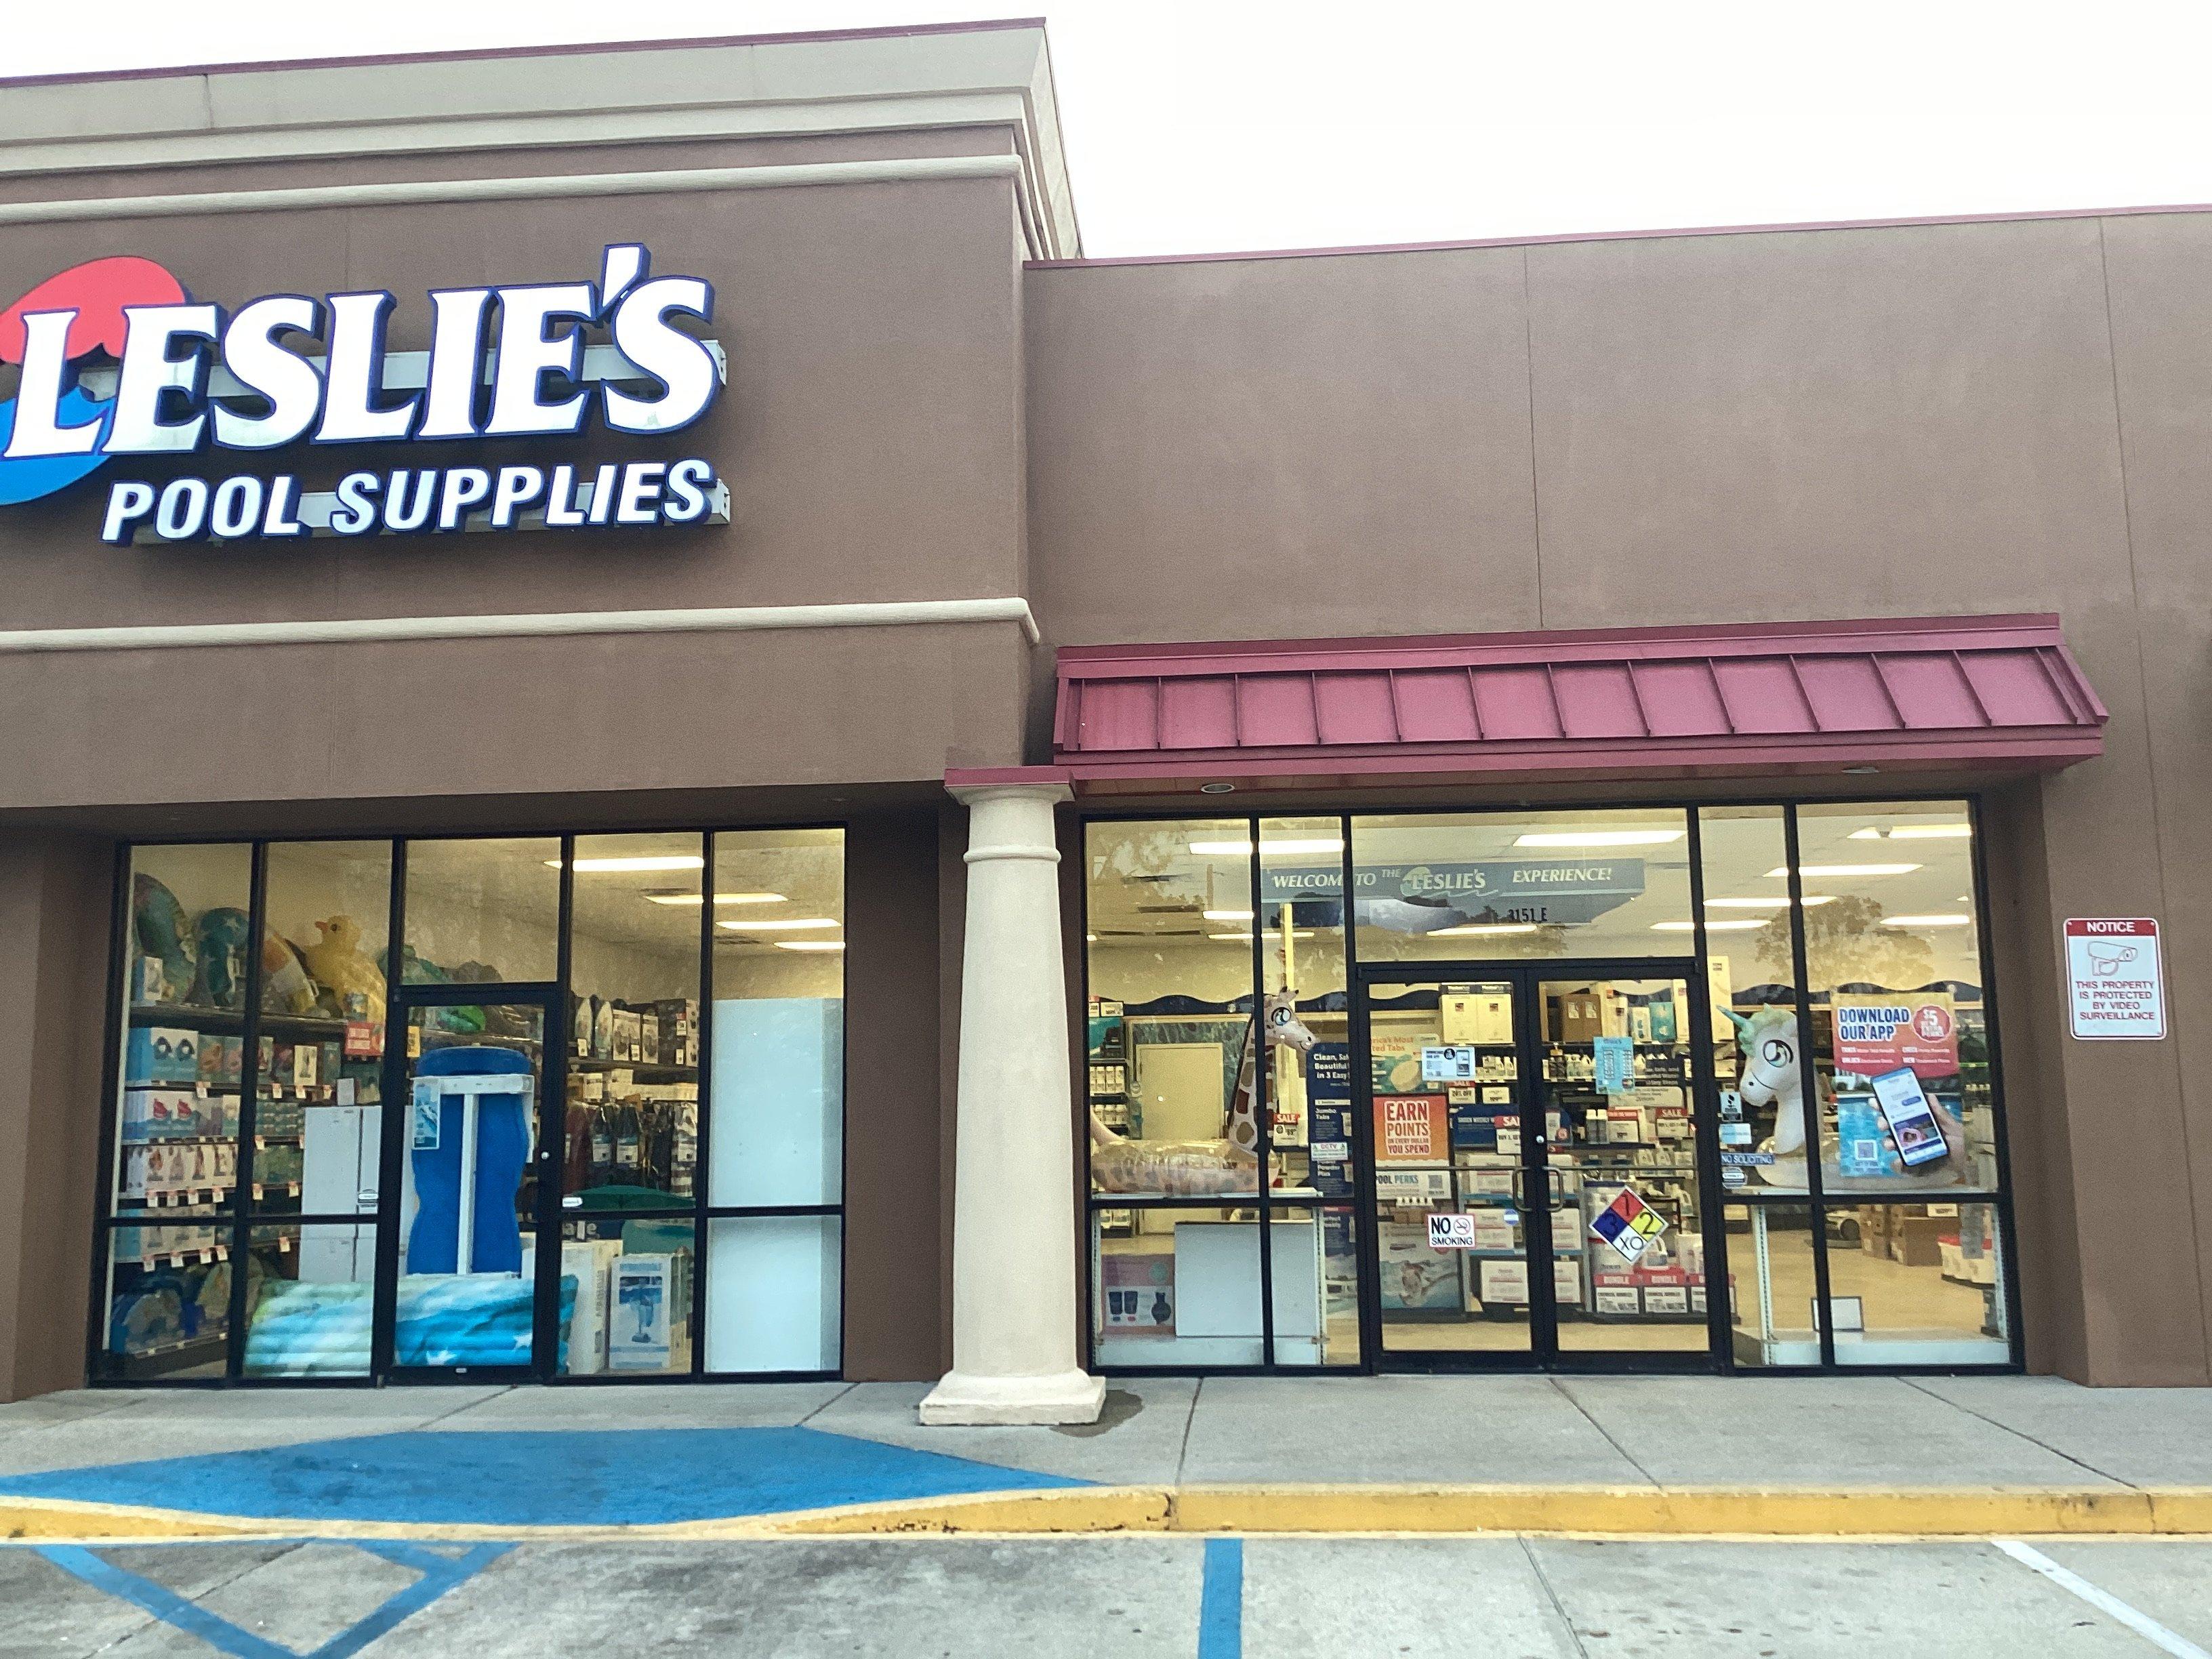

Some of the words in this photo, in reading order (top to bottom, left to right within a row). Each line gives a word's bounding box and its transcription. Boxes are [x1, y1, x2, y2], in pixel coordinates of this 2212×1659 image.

[3, 242, 717, 459] LESLIE'S
[100, 474, 302, 543] POOL
[329, 458, 716, 535] SUPPLIES
[1272, 874, 1343, 888] WELCOM
[1354, 872, 1376, 886] TO
[1381, 868, 1401, 878] THE
[1412, 868, 1486, 890] LESLIE'S
[1512, 867, 1612, 884] EXPERIENCE!
[2087, 921, 2136, 933] NOTICE
[2076, 981, 2098, 989] THIS
[2102, 981, 2154, 989] PROPERTY
[2079, 991, 2089, 1000] IS
[2093, 991, 2153, 1000] PROTECTED
[2092, 1002, 2106, 1010] BY
[2110, 1002, 2141, 1010] VIDEO
[1839, 1008, 1910, 1023] DOWNLOAD
[2079, 1012, 2156, 1021] SURVEILLANCE
[1841, 1025, 1866, 1040] OUR
[1870, 1025, 1895, 1040] APP
[1313, 1053, 1338, 1061] Clean,
[1277, 1113, 1296, 1123] SALE
[1386, 1103, 1428, 1122] EARN
[1661, 1109, 1682, 1117] SALE
[1387, 1122, 1429, 1136] POINTS
[1388, 1145, 1403, 1154] YOU
[1405, 1145, 1429, 1153] SPEND
[1721, 1153, 1732, 1164] NO
[1732, 1153, 1774, 1164] SOLICITING
[1394, 1174, 1419, 1185] PERKS
[1620, 1193, 1631, 1216] 1
[1431, 1217, 1451, 1235] NO
[1639, 1211, 1656, 1235] 2
[1431, 1237, 1473, 1246] SMOKING
